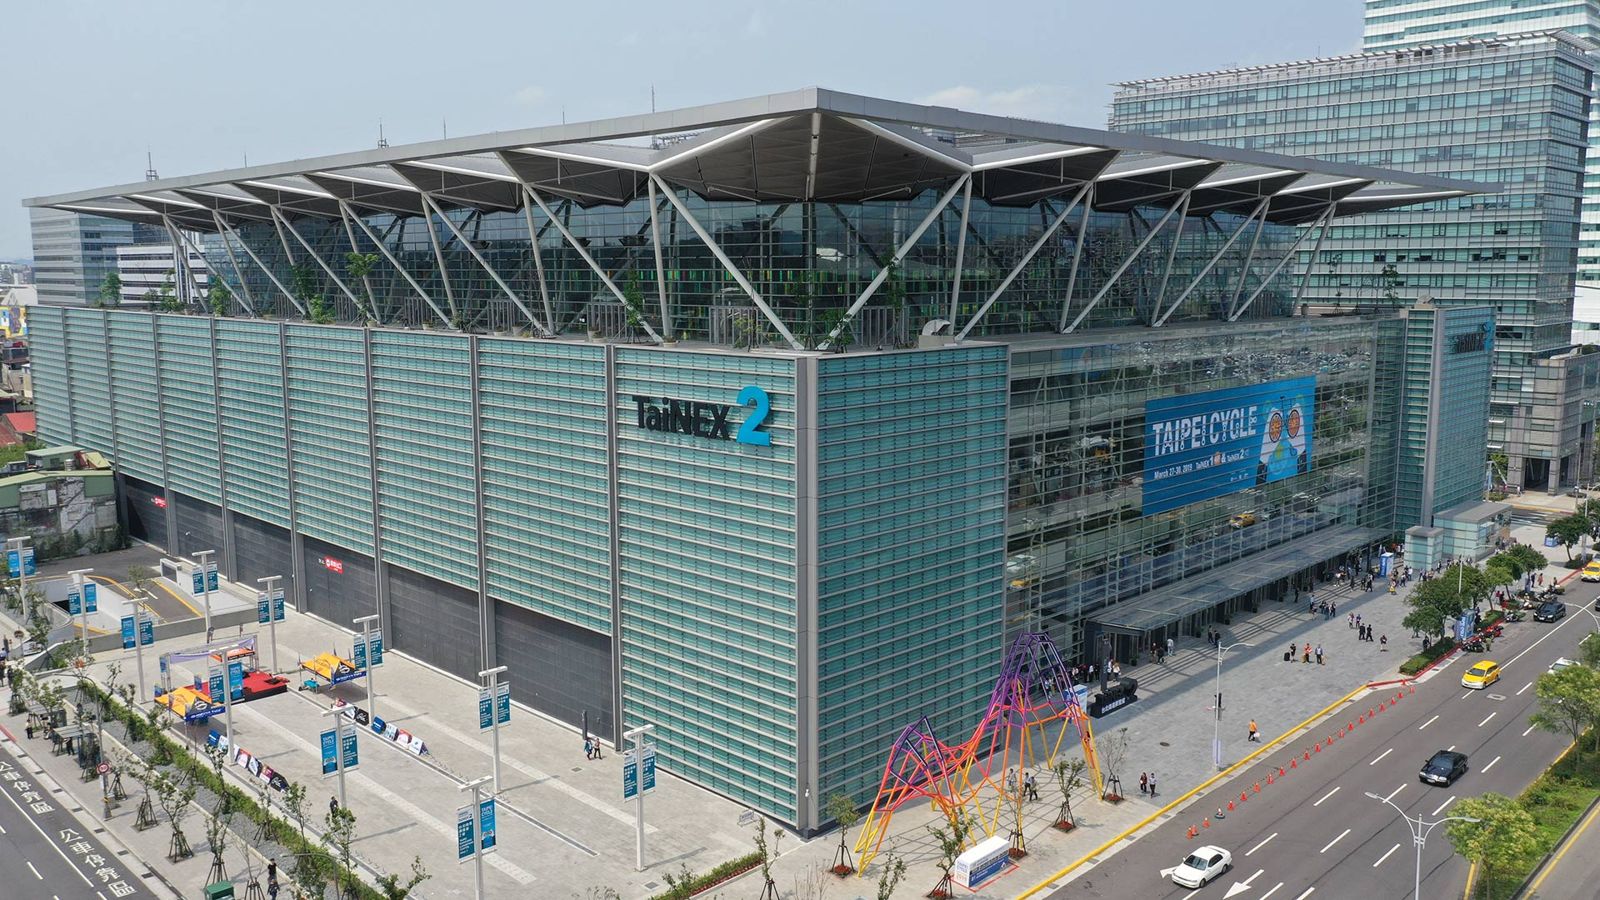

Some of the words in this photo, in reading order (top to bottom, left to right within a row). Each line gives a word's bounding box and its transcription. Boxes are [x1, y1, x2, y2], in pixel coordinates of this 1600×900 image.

[632, 395, 732, 441] TaiNEX
[736, 385, 770, 447] 2
[1152, 414, 1207, 457] TAIPEI
[1209, 405, 1258, 444] CYCLE
[1154, 470, 1169, 480] March
[59, 828, 137, 898] 公車停靠區
